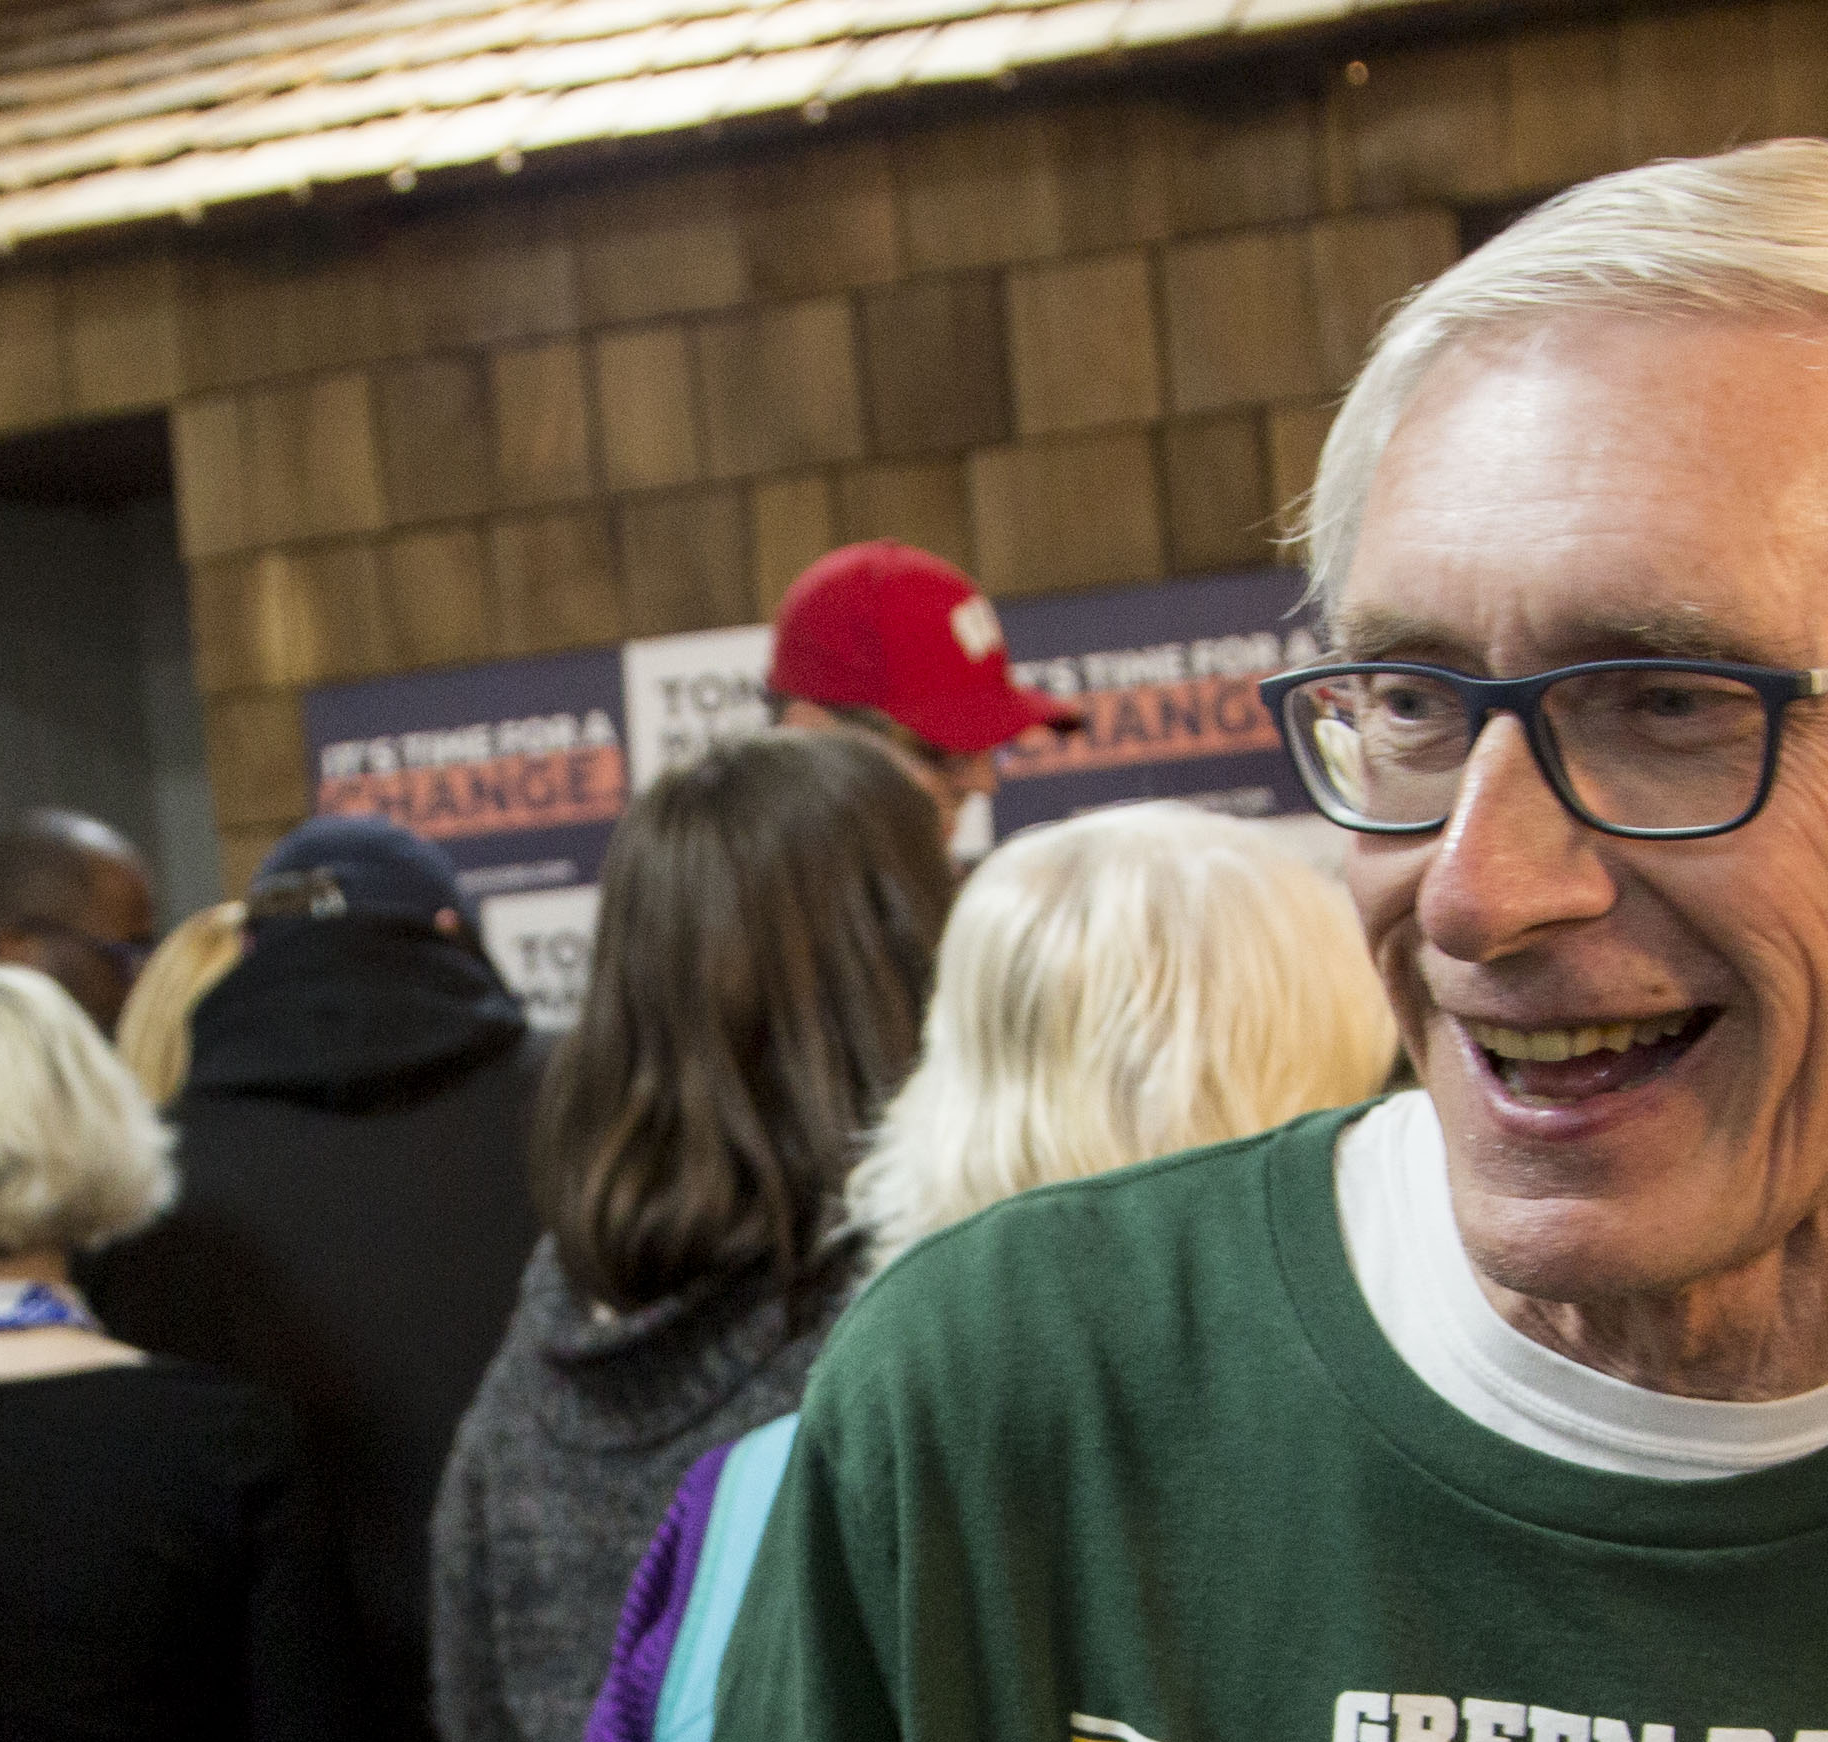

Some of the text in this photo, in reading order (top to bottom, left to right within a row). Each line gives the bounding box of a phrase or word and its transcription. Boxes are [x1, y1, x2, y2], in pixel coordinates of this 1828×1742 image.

[1083, 642, 1186, 690] TIME
[1189, 631, 1279, 678] FOR
[658, 670, 770, 716] TON
[401, 722, 493, 770] TIME
[497, 712, 575, 758] FOR
[580, 708, 618, 746] A
